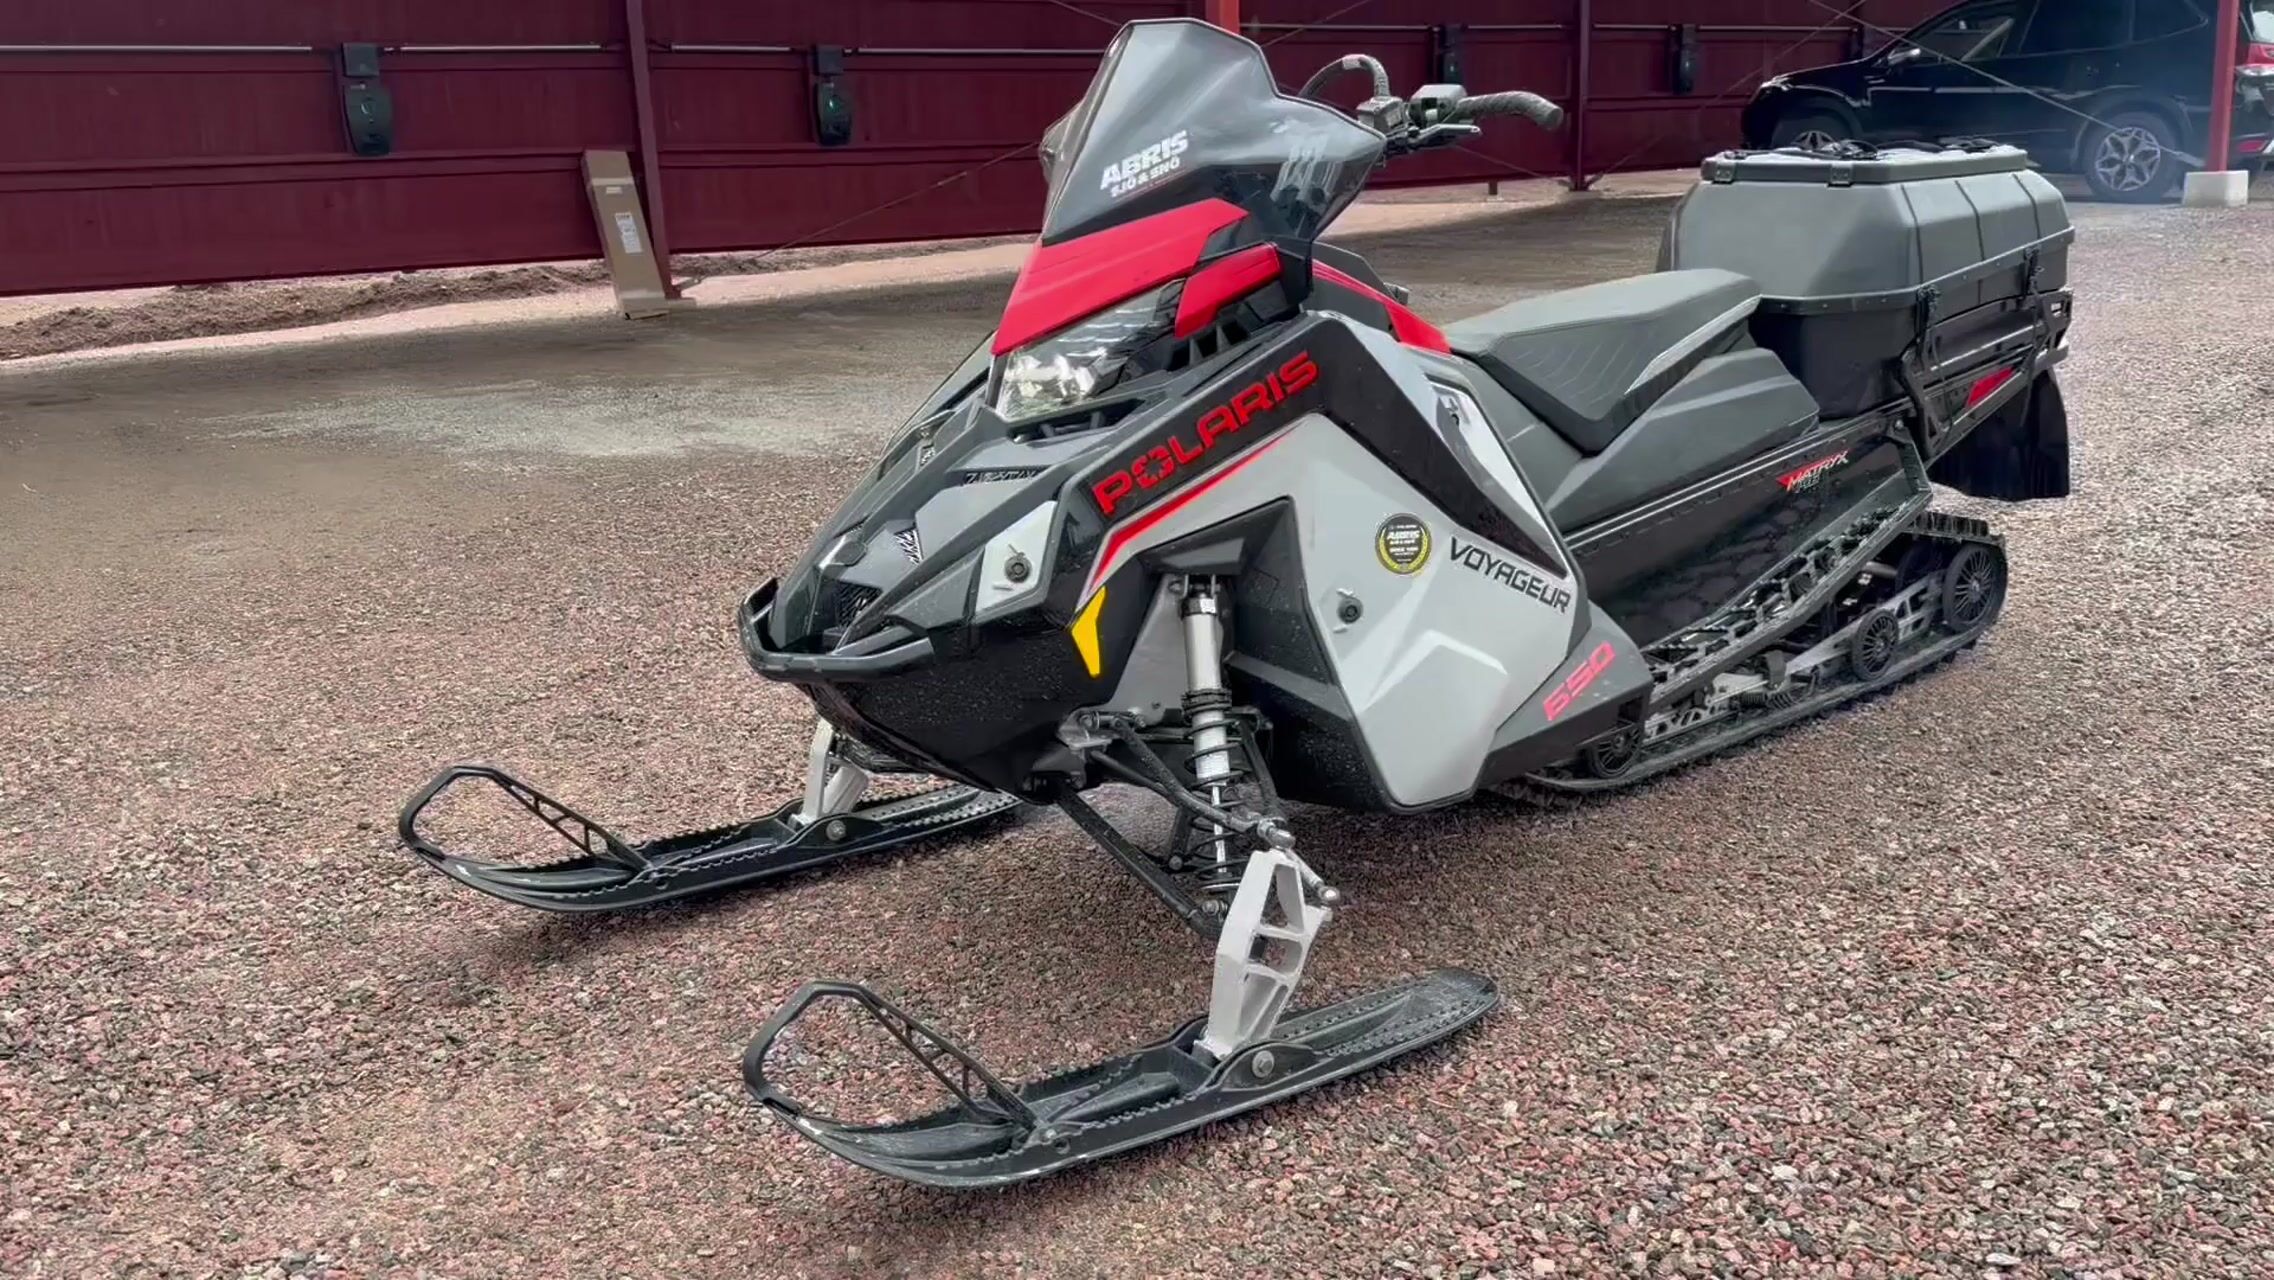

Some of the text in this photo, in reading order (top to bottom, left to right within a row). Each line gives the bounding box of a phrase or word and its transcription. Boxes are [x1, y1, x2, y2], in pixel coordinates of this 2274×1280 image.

[1100, 130, 1188, 190] ABRIS
[1092, 351, 1319, 514] POLARIS
[1786, 450, 1849, 492] MATRYX
[1450, 536, 1571, 614] VOYAGEUR
[1543, 641, 1616, 721] 650
